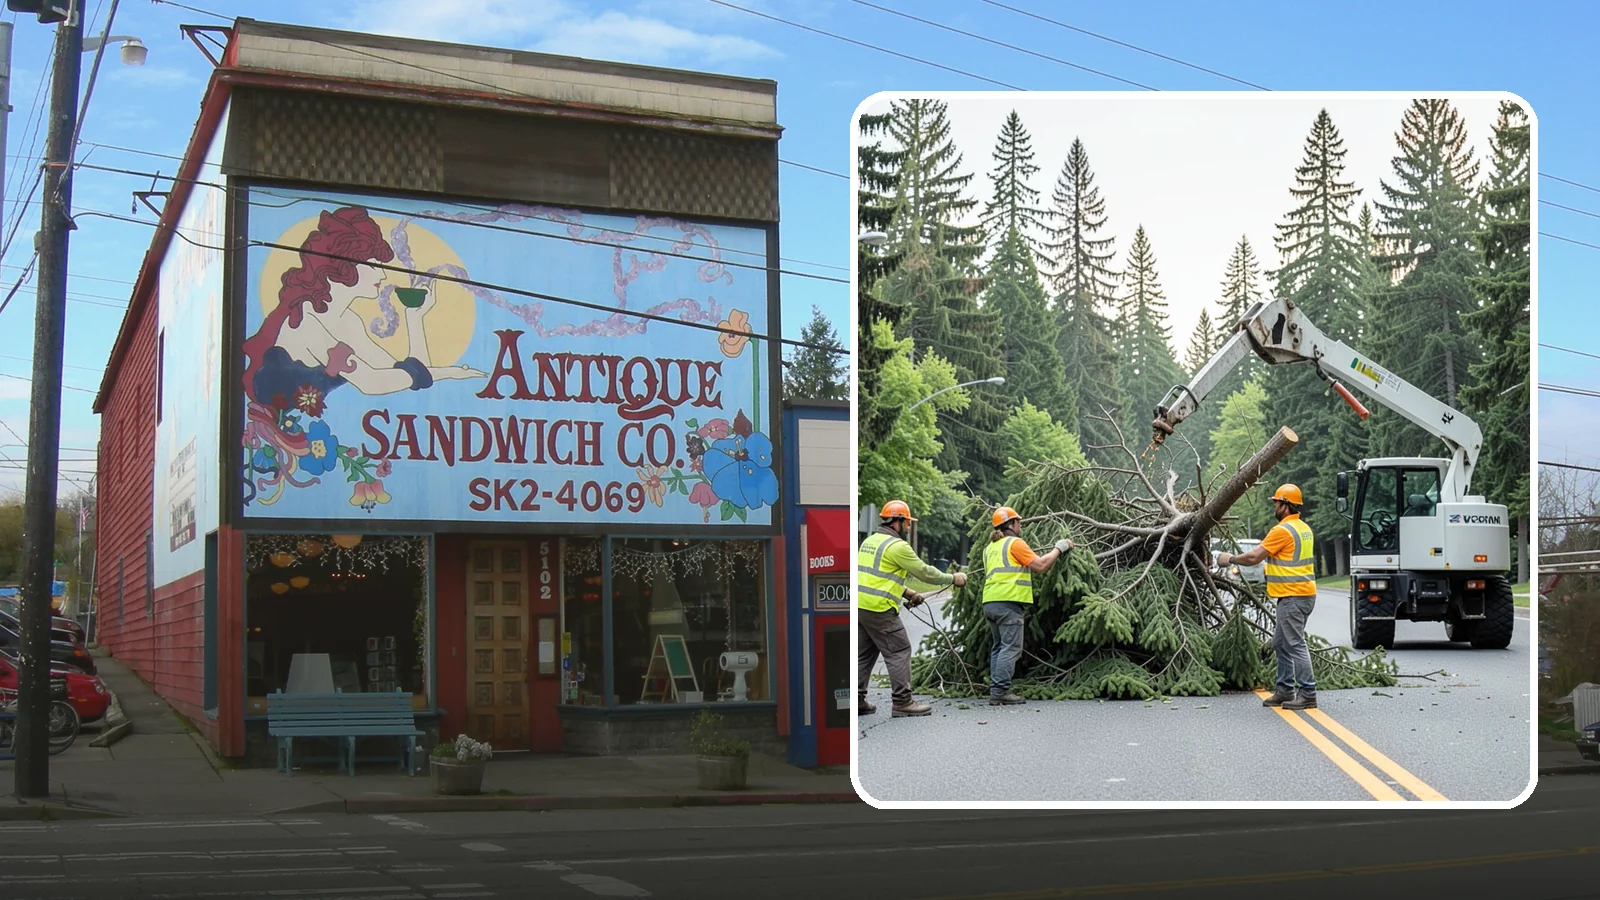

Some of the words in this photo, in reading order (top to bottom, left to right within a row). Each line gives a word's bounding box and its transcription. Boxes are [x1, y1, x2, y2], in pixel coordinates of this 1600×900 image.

[476, 329, 724, 421] ANTIQUE
[361, 408, 605, 467] SANDWICH
[617, 421, 686, 469] CO.
[467, 477, 646, 513] SK2-4069
[540, 541, 551, 600] 5102
[809, 555, 835, 569] BOOKS
